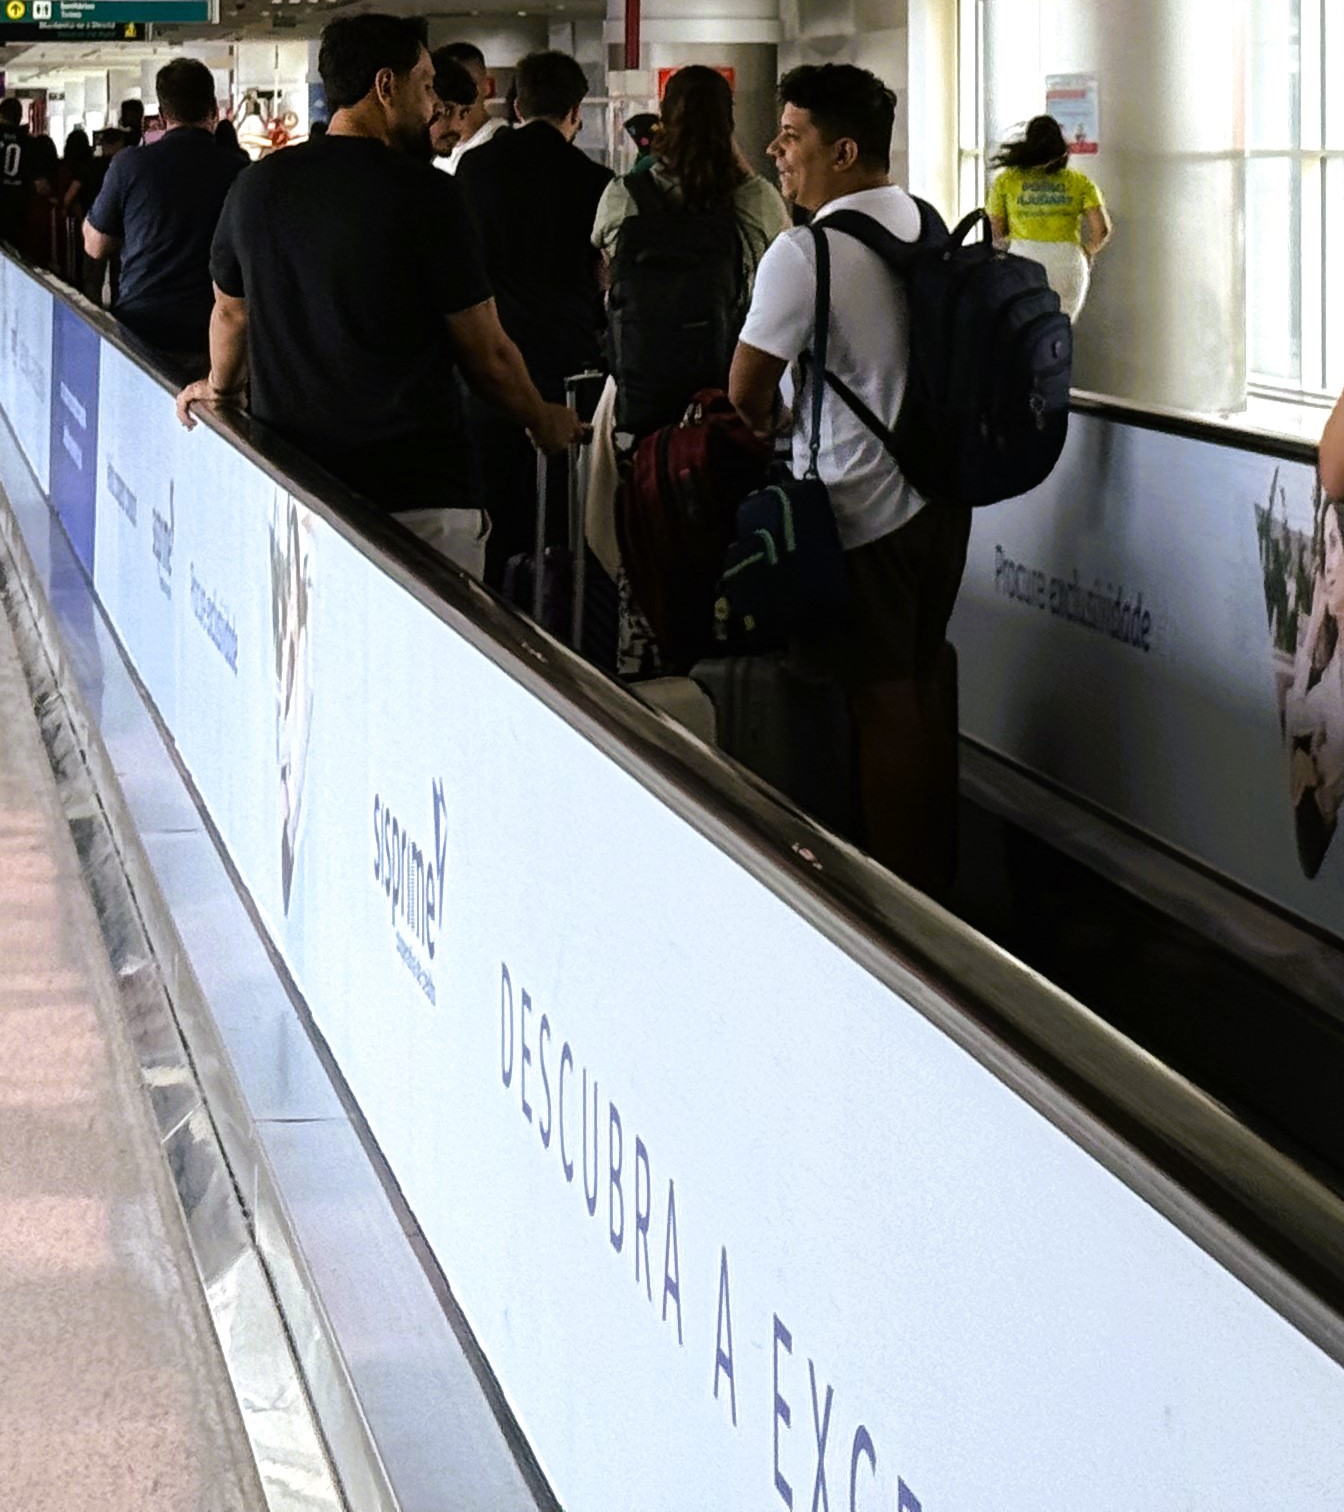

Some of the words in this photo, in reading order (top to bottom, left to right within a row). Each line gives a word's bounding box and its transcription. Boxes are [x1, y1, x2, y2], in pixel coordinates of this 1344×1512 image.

[500, 961, 684, 1346] DESCUBRA
[713, 1245, 737, 1427] A
[772, 1311, 923, 1512] EX
